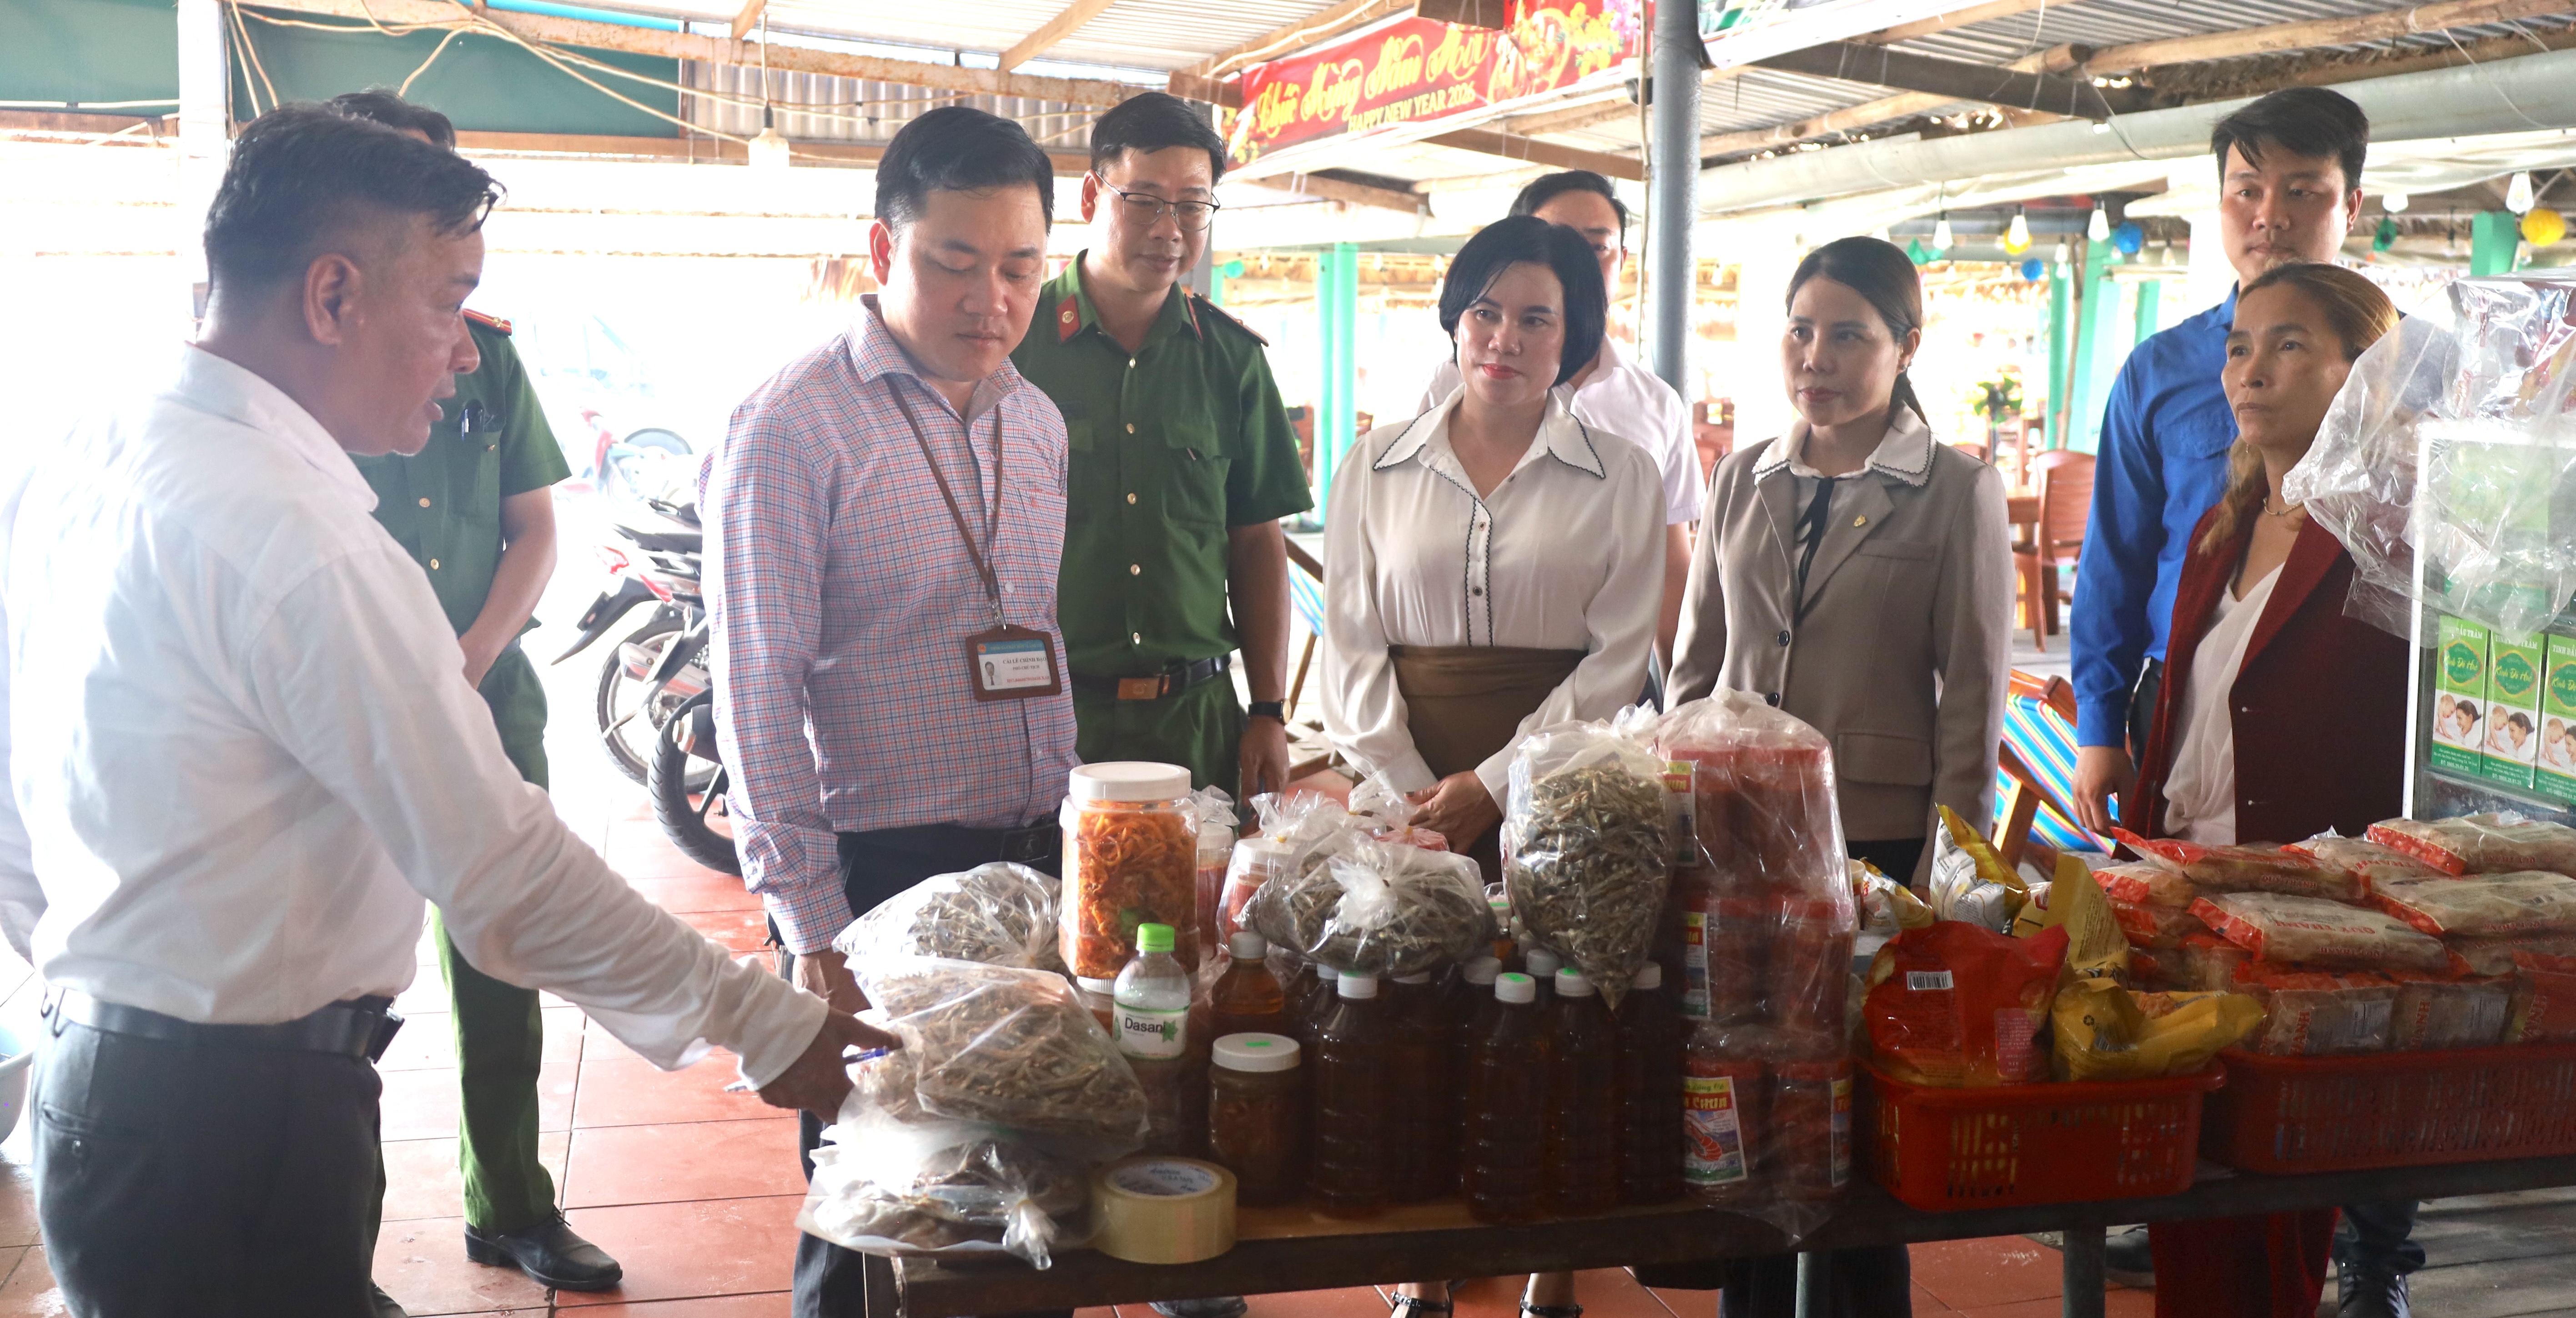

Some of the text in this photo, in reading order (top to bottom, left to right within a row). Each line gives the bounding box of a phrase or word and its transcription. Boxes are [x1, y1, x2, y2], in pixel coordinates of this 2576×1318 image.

[1348, 80, 1477, 134] HAPPY NEW YEAR 2026
